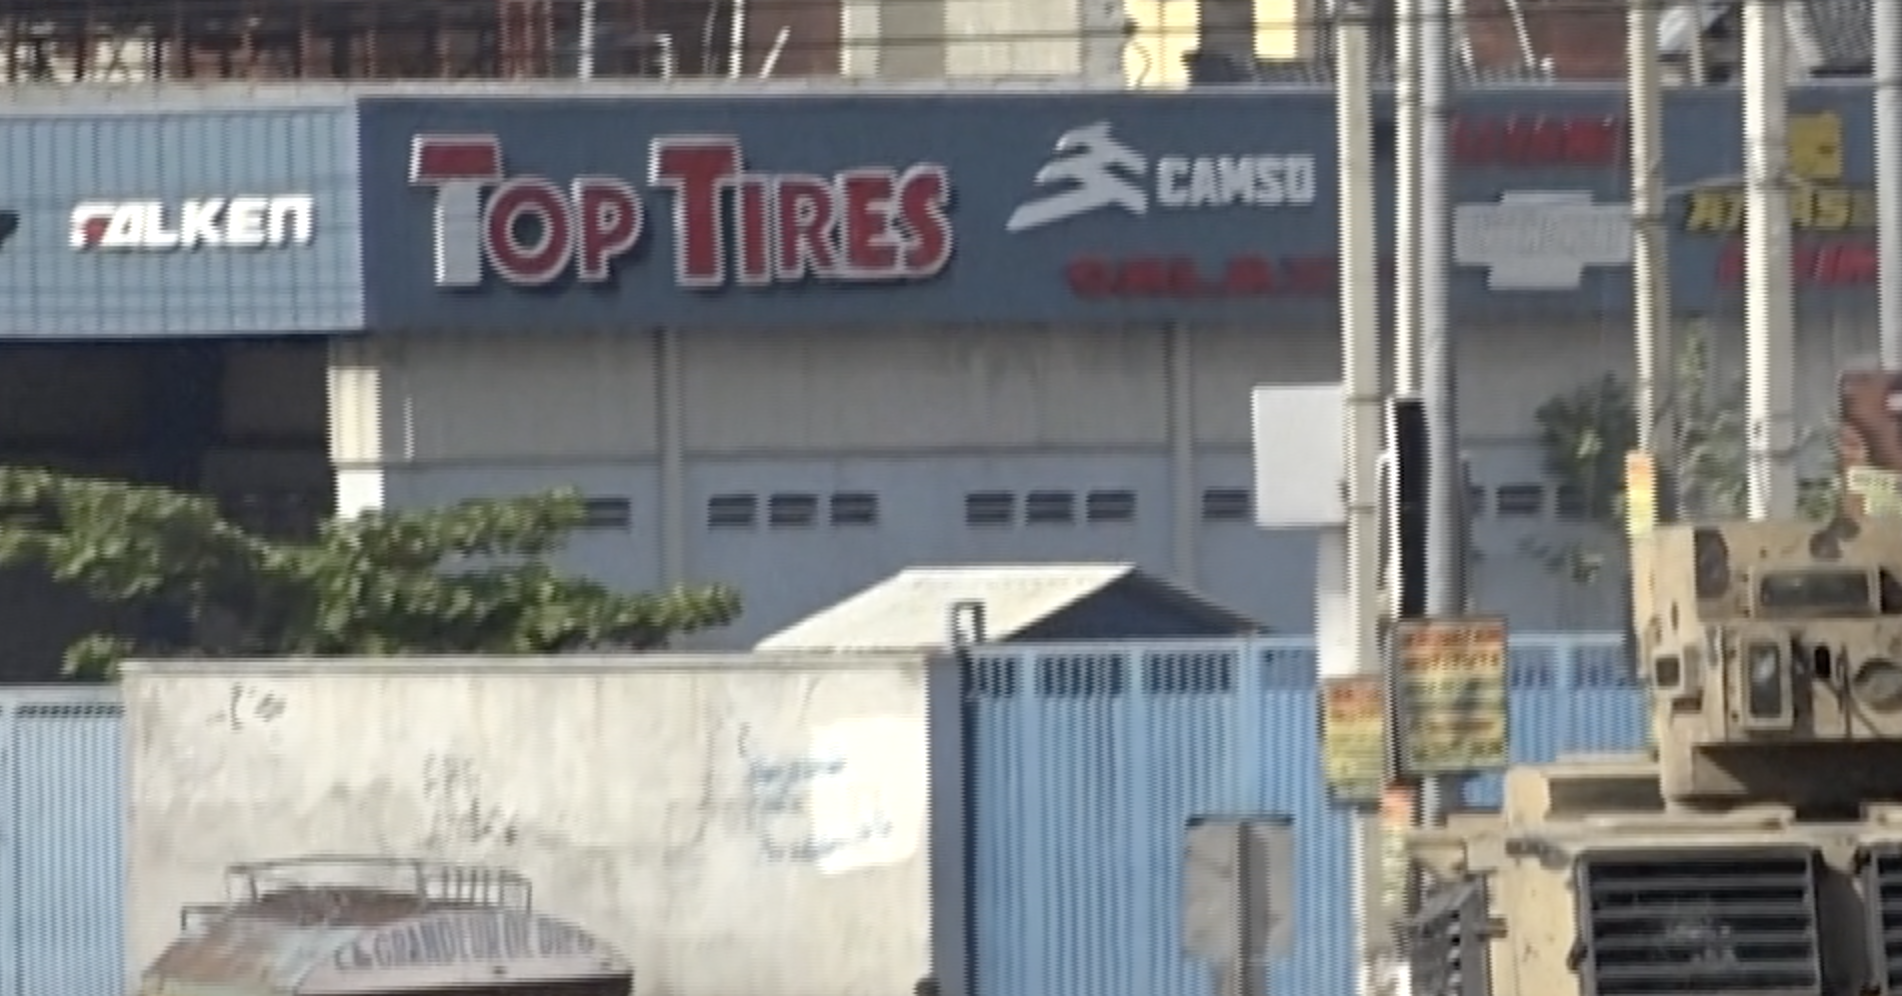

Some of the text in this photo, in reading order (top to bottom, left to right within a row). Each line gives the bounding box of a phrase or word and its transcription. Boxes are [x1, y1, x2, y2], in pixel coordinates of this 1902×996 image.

[1156, 154, 1317, 206] CAMSO
[69, 195, 316, 248] FALKEN
[410, 134, 955, 287] TOP TIRES
